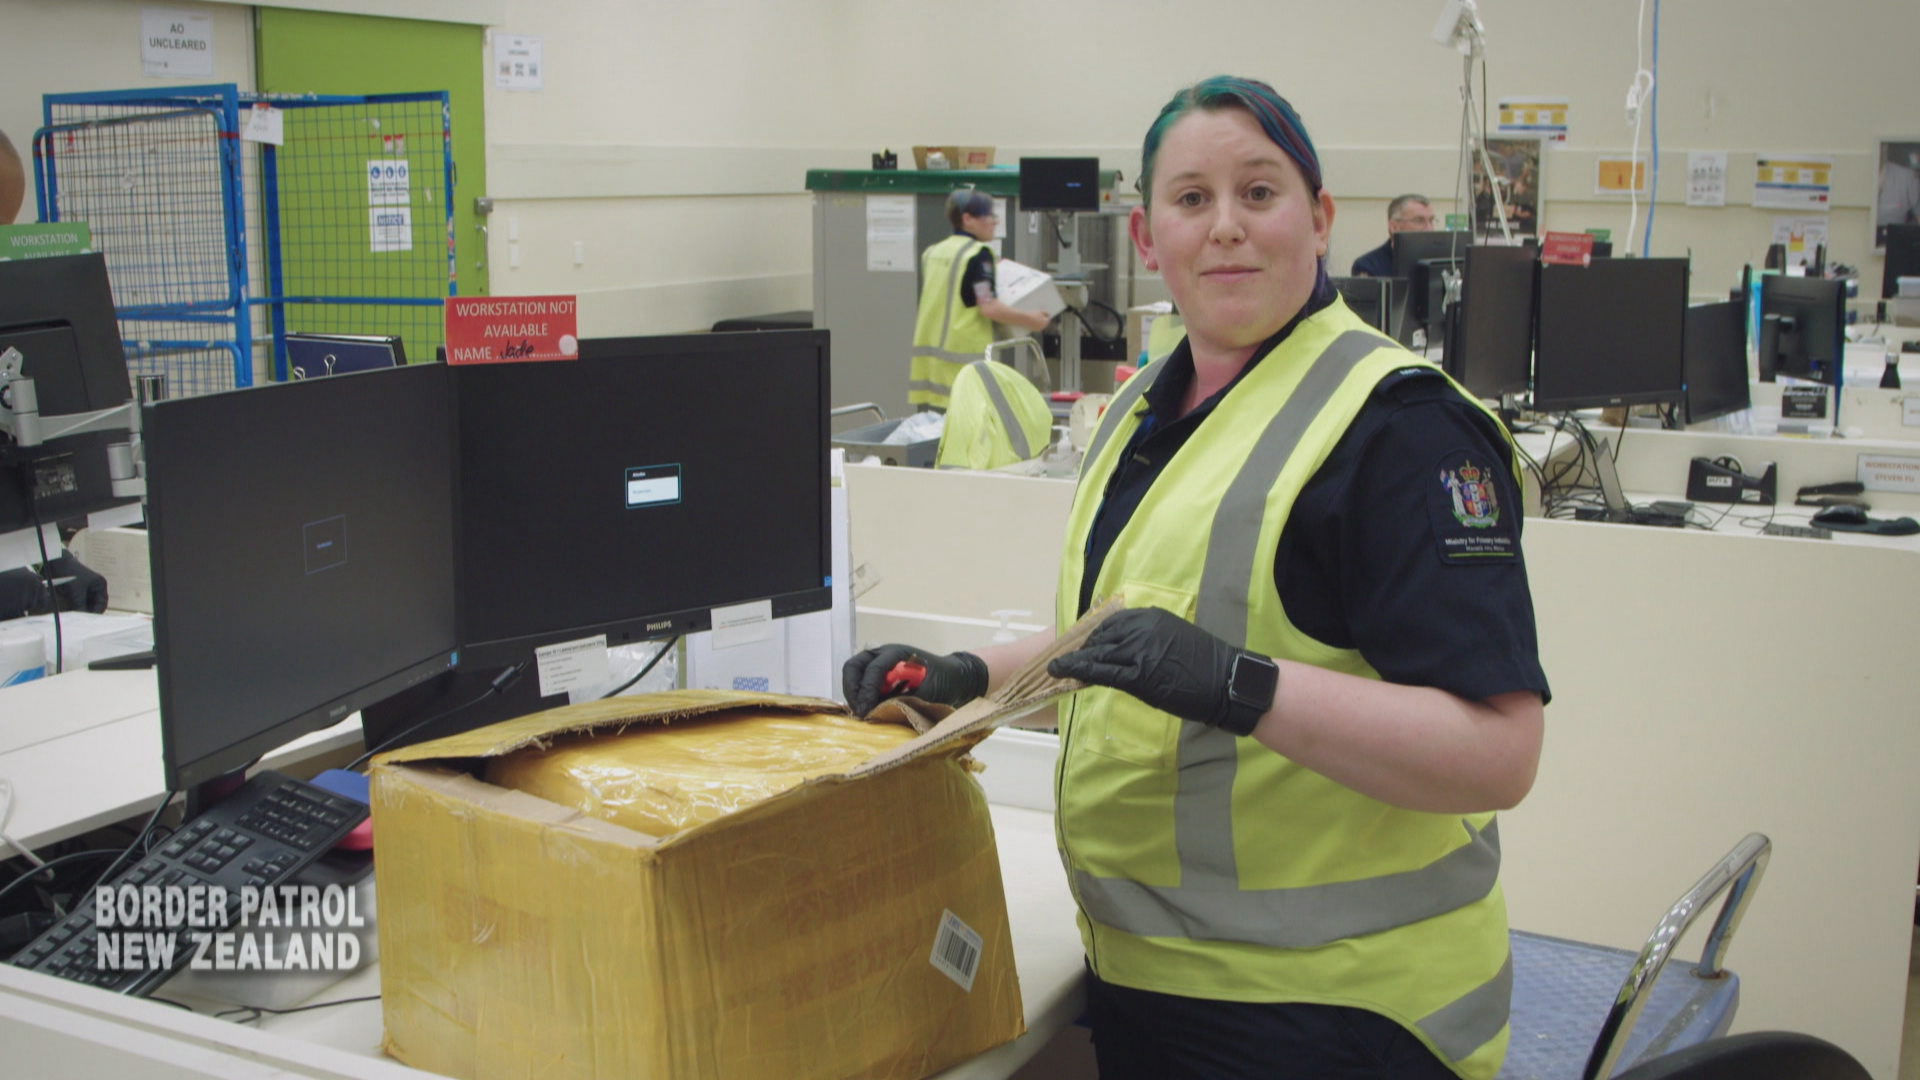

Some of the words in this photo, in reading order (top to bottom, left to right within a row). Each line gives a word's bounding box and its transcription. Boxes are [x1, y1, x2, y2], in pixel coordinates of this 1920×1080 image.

[170, 23, 185, 35] AO
[149, 36, 207, 51] UNCLEARED
[10, 233, 78, 247] WORKSTATION
[456, 302, 546, 317] WORKSTATION
[549, 300, 575, 315] NOT
[484, 323, 548, 338] AVAILABLE
[454, 346, 492, 361] NAME
[1865, 461, 1920, 471] WORKSTATION
[1875, 472, 1903, 481] STEVEN
[1445, 537, 1468, 546] Ministry
[646, 620, 672, 632] PHILIPS
